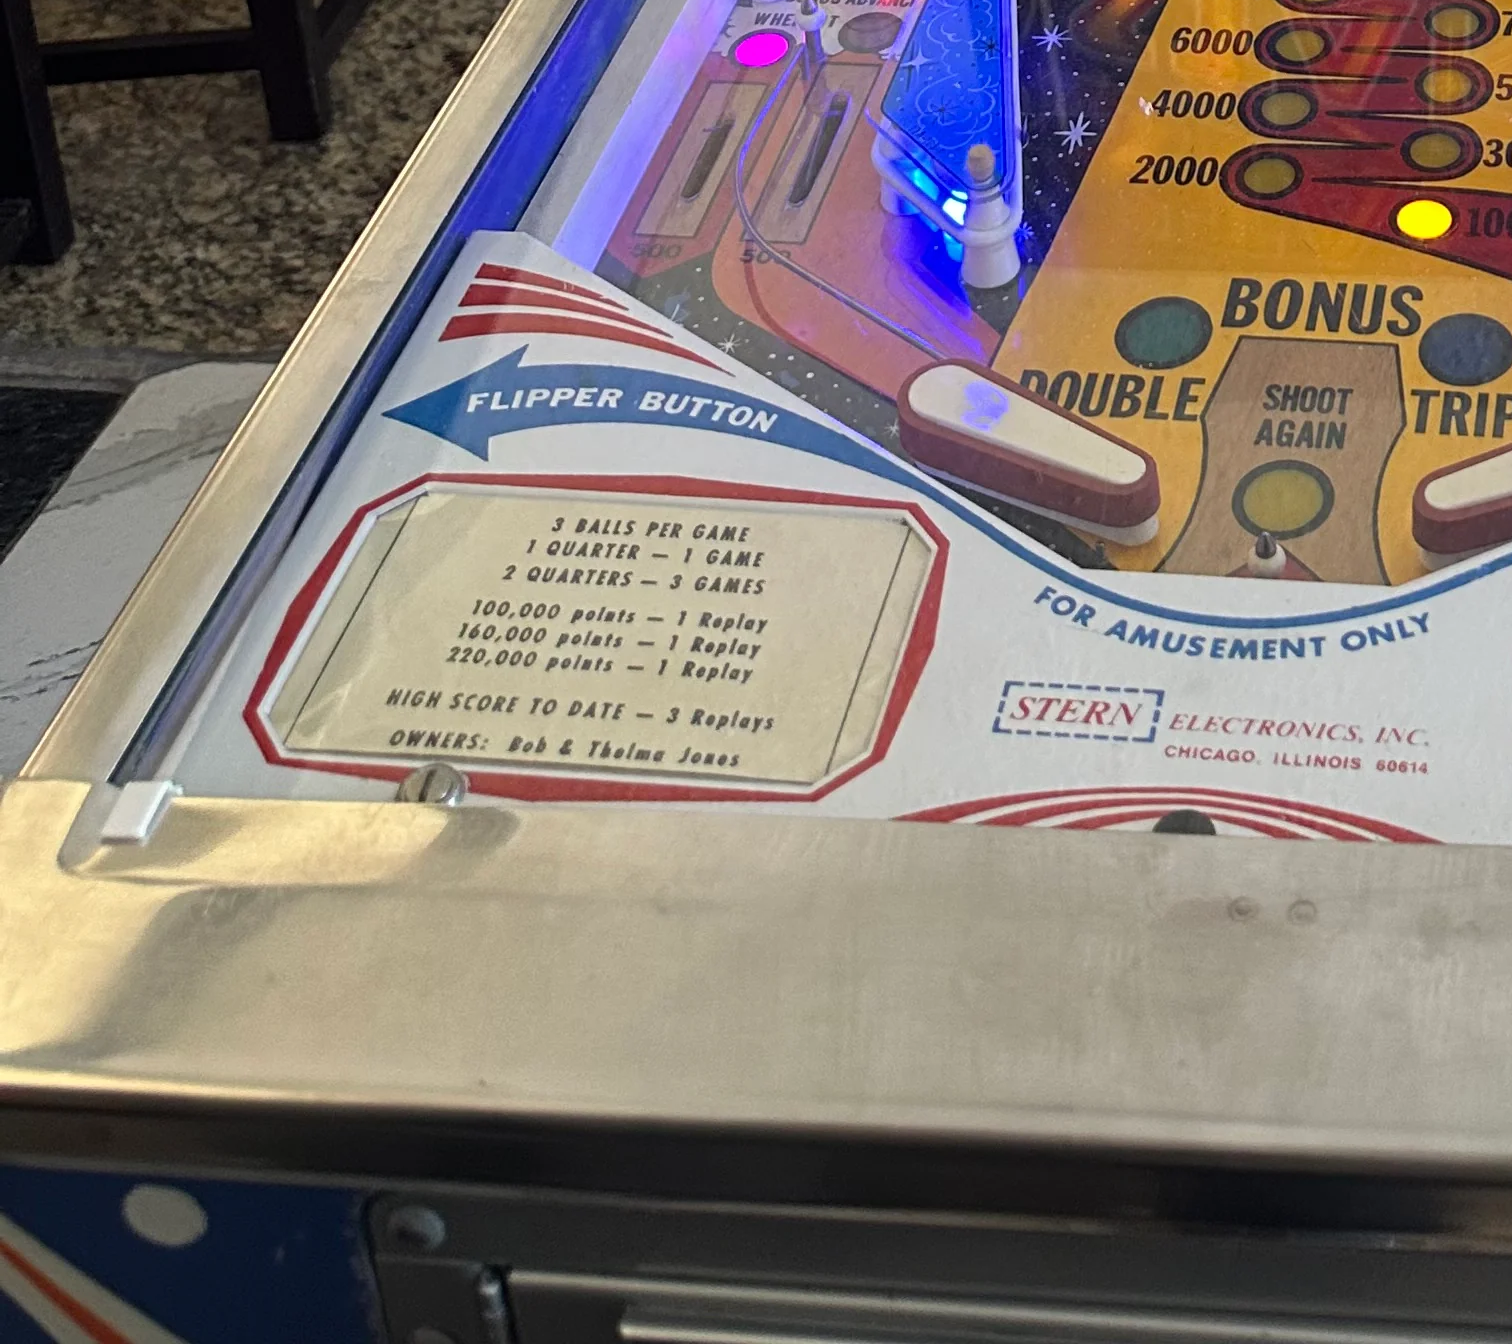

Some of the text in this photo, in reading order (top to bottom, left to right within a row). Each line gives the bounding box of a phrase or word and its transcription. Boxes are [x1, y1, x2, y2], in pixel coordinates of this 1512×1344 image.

[1170, 27, 1254, 55] 6000
[1152, 89, 1237, 120] 4000
[1130, 155, 1220, 186] 2000
[633, 242, 682, 260] 500
[1221, 278, 1424, 338] BONUS
[466, 386, 778, 434] FLIPPER BUTTON
[1263, 383, 1353, 416] SHOOT
[1253, 419, 1347, 449] AGAIN
[551, 516, 750, 542] 3 BALLS PER GAME
[526, 538, 765, 567] 1 QUARTER 1 GAME
[502, 564, 766, 595] 2 QUARTERS 3 GAMES
[472, 599, 768, 634] 100,000 points 1 Replay
[1034, 585, 1430, 662] FOR AMUSEMENT ONLY
[458, 622, 761, 660] 160,000 points 1 Replay
[446, 646, 753, 685] 220,000 points 1 Replay
[386, 688, 775, 732] HIGH SCORE TO DATE 3 Replays
[1009, 696, 1431, 747] STERN ELECTRONICS, INC.
[389, 729, 741, 768] OWNERS: Bob & Thelma Jones
[1272, 753, 1361, 771] ILLINOIS
[1375, 758, 1429, 775] 60614
